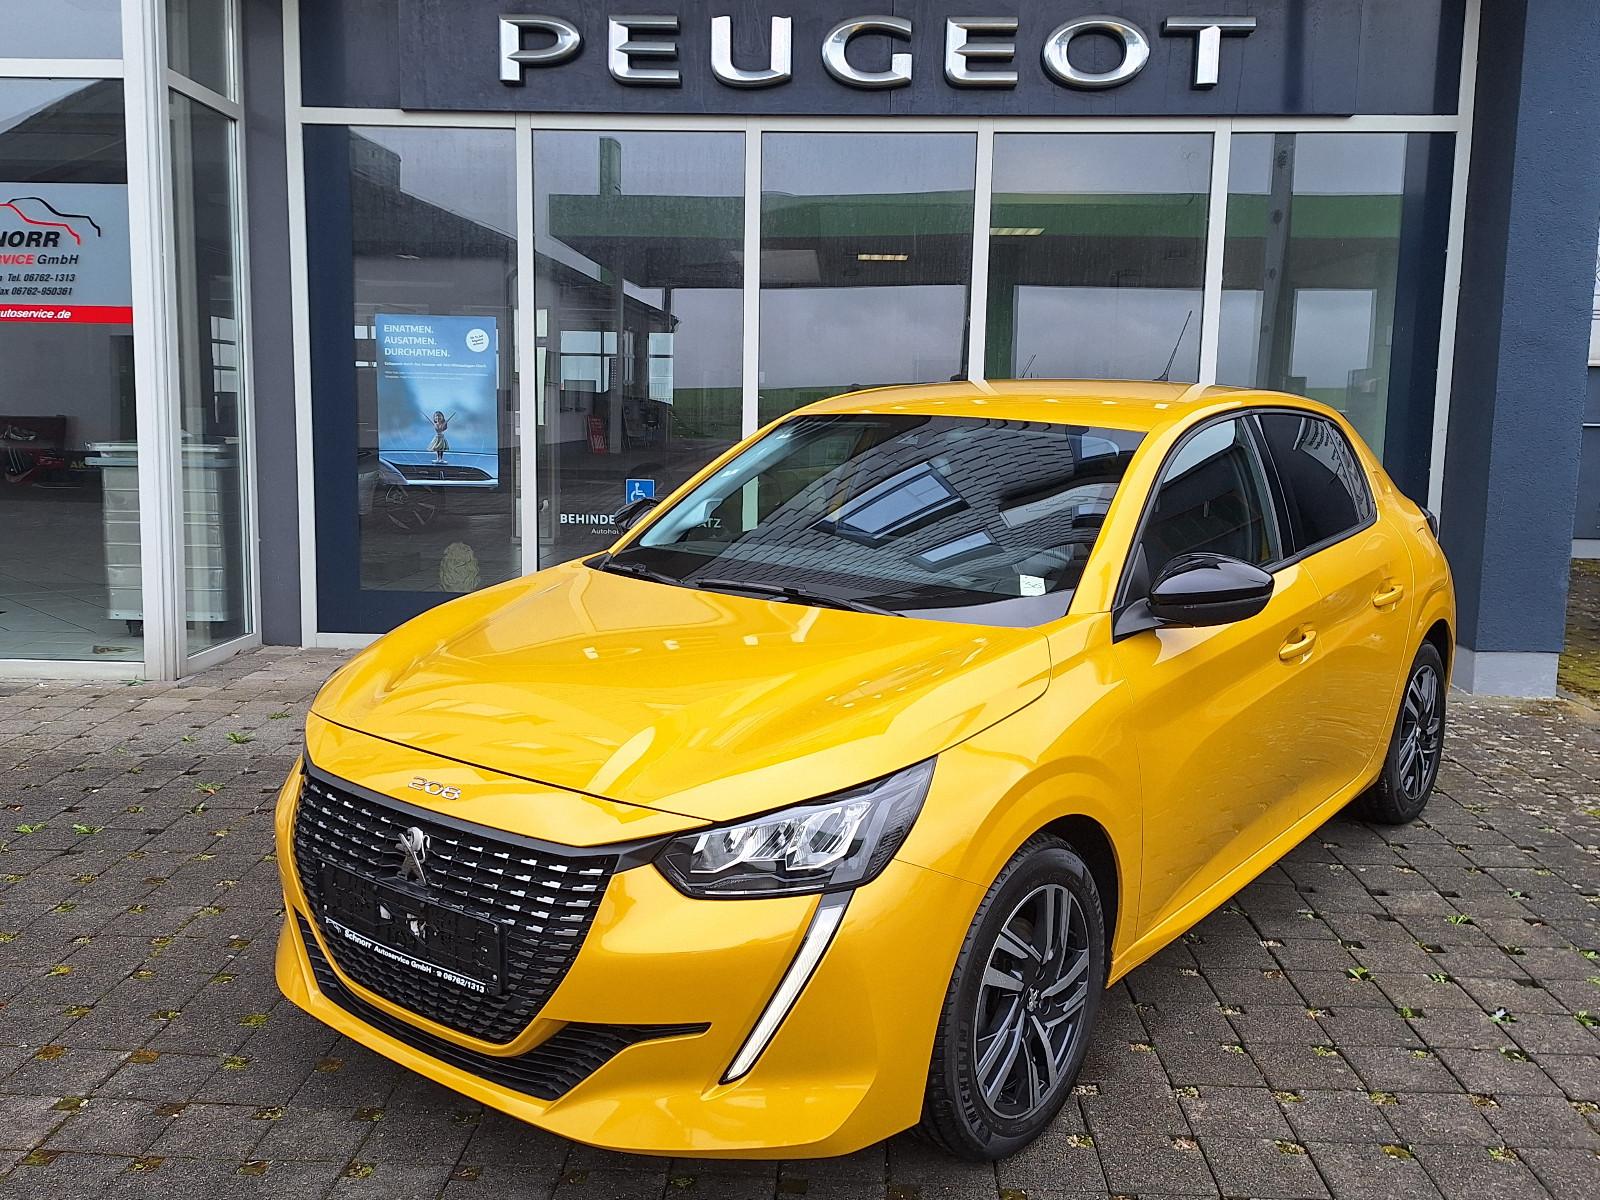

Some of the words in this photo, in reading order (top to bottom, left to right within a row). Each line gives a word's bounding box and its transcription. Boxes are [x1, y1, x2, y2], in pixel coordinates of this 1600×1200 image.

[498, 14, 1257, 89] PEUGEOT
[37, 254, 79, 264] GmbH
[8, 273, 21, 282] Tel.
[23, 274, 75, 282] 06762-1313
[11, 287, 72, 295] 06762-950361
[0, 309, 71, 318] utoservice.de
[383, 324, 434, 334] EINATMEN.
[384, 335, 437, 345] AUSATMEN.
[384, 347, 451, 357] DURCHATMEN.
[408, 776, 462, 800] 208
[344, 928, 372, 949] Schnorr
[373, 945, 410, 966] Autoservice
[410, 960, 432, 974] GmbH
